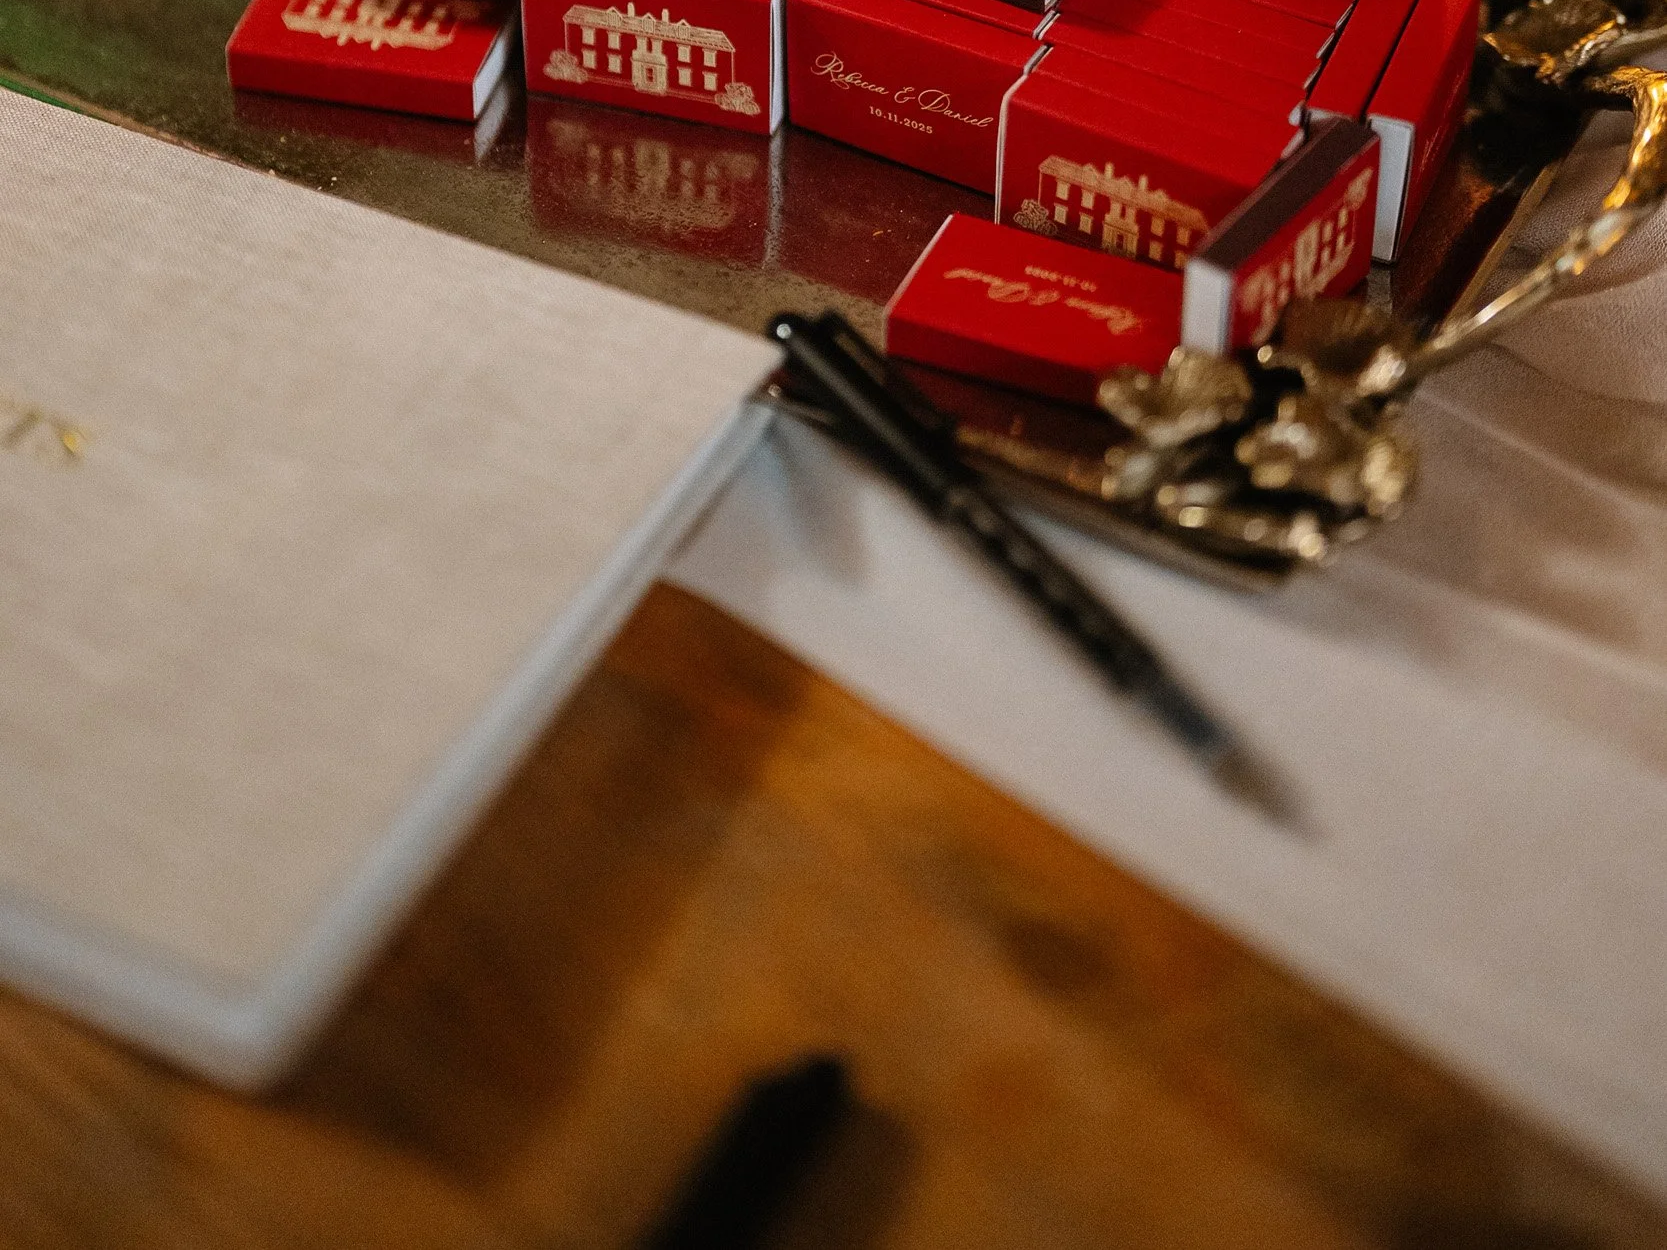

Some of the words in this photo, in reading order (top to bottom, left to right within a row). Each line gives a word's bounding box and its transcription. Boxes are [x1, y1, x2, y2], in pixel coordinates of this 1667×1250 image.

[810, 51, 889, 95] Rebecca
[894, 86, 916, 104] &
[918, 89, 994, 128] Daniel
[868, 106, 933, 134] 10.11.2025
